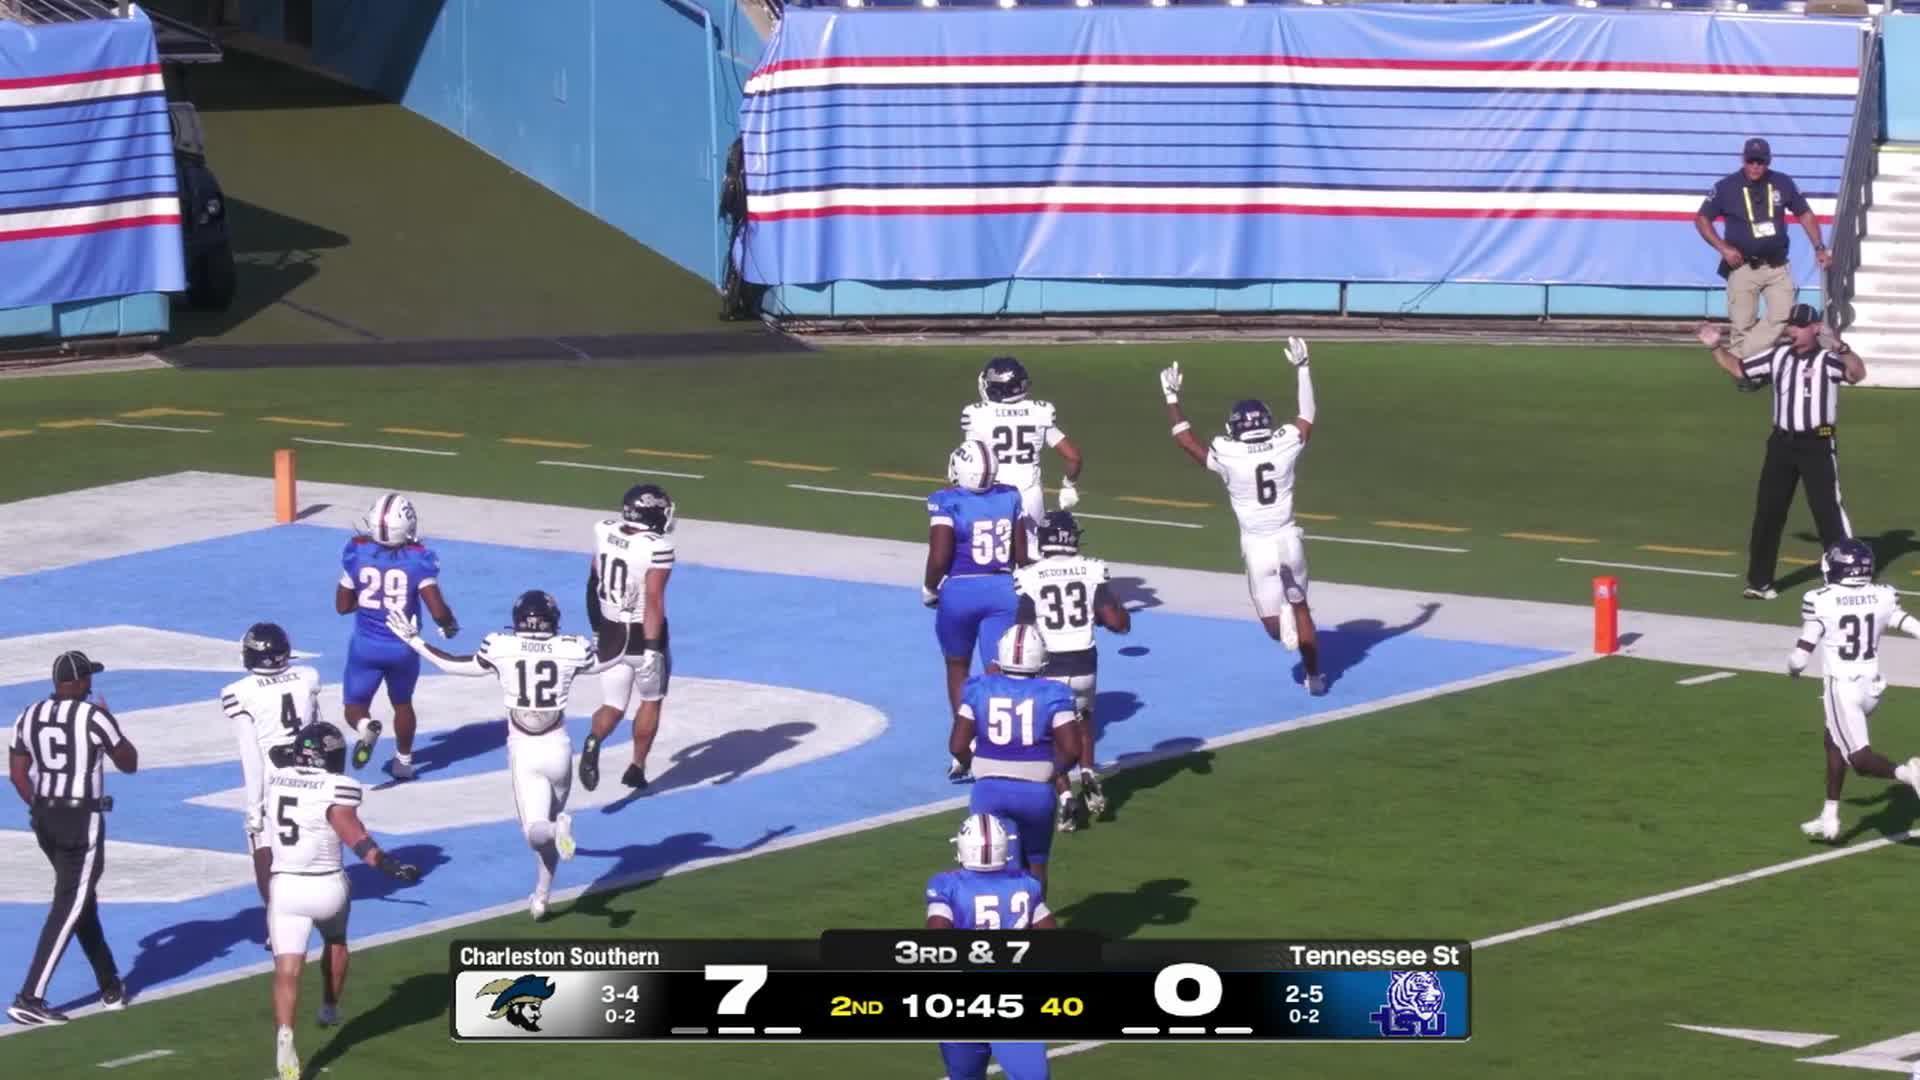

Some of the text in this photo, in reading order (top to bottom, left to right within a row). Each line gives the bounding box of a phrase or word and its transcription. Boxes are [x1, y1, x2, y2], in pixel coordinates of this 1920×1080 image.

[995, 408, 1030, 417] LENNON
[992, 425, 1036, 465] 25
[1255, 462, 1277, 506] 6
[972, 518, 1012, 565] 53
[359, 567, 408, 610] 29
[599, 553, 628, 604] 10
[1038, 567, 1087, 579] MCDONALD
[1040, 581, 1089, 630] 33
[1836, 594, 1879, 606] ROBERTS
[520, 641, 553, 654] HOOKS
[1838, 613, 1876, 661] 31
[256, 673, 301, 688] HANCOCK
[515, 660, 558, 708] 12
[281, 692, 303, 736] 4
[988, 697, 1035, 746] 51
[38, 726, 67, 770] C
[277, 795, 299, 846] 5
[973, 891, 1031, 929] 52
